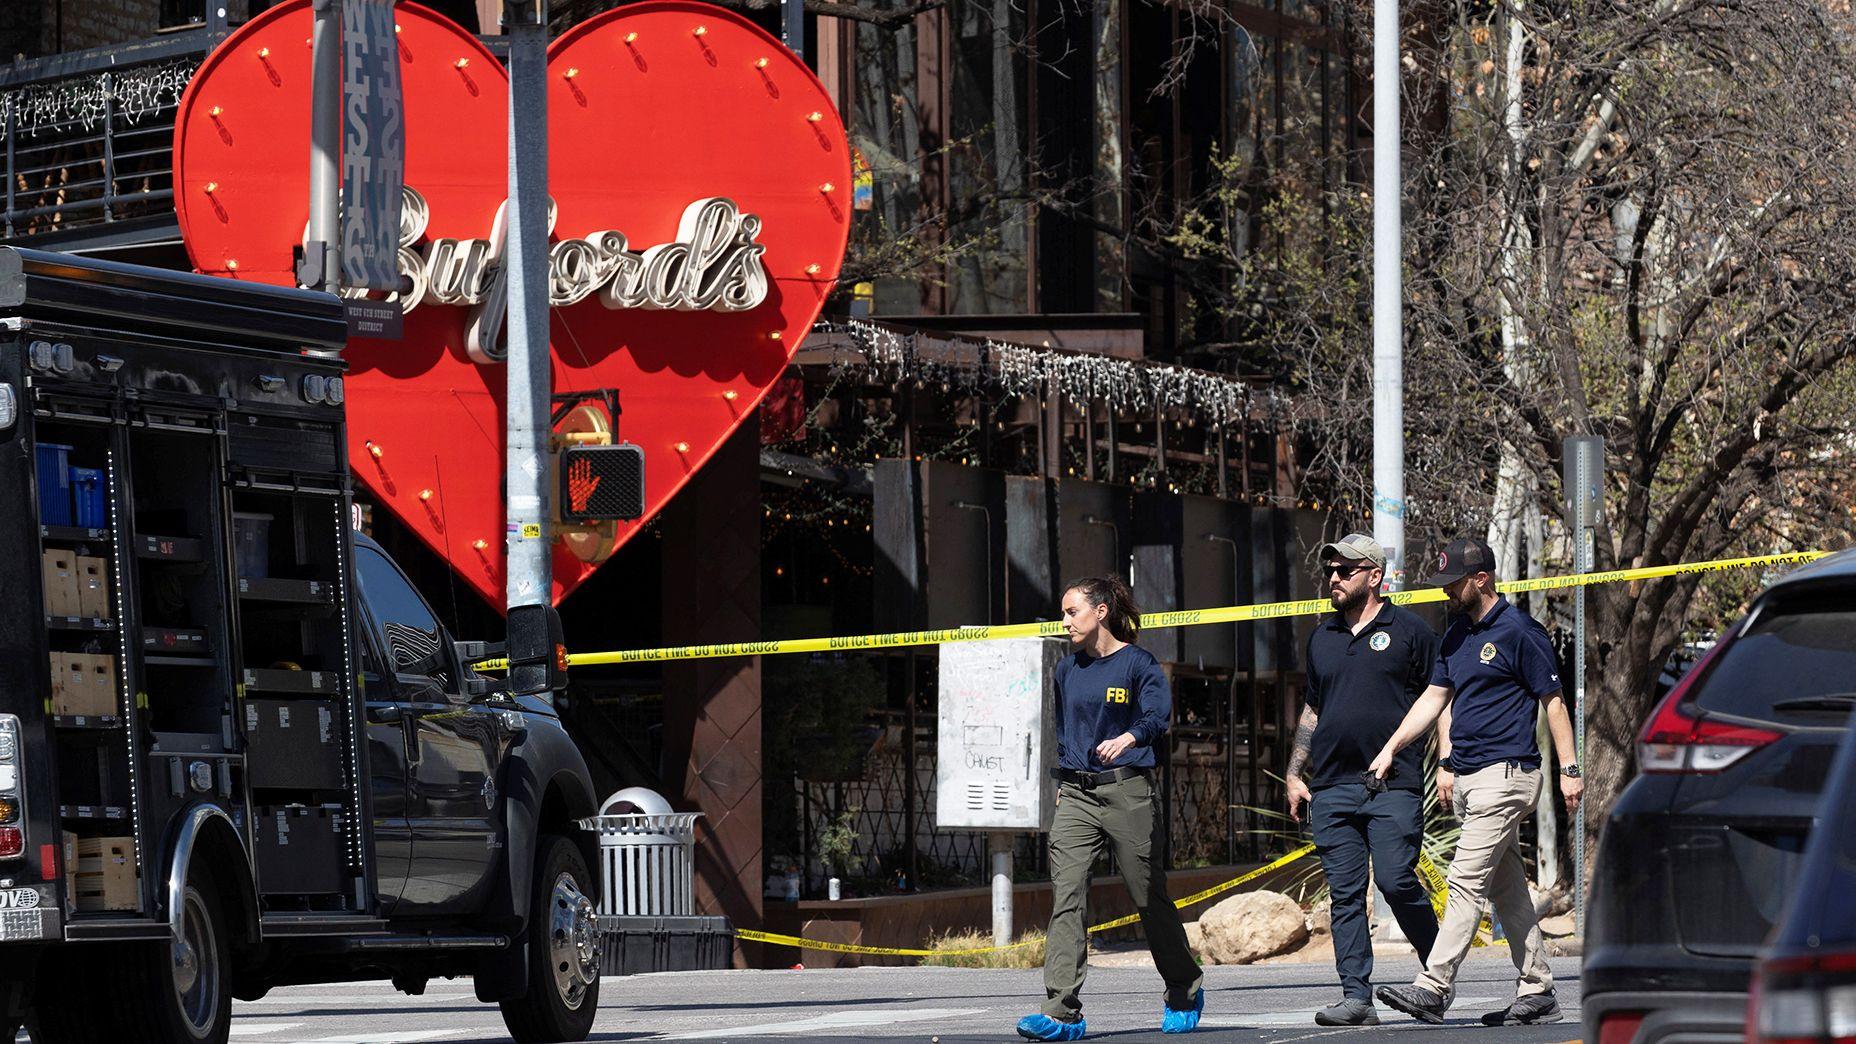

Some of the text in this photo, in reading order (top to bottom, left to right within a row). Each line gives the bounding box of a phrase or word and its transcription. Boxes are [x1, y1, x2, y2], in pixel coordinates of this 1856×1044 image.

[343, 0, 370, 216] WEST
[348, 306, 362, 317] WEST
[374, 309, 394, 320] STREET
[357, 321, 384, 332] DISTRICT
